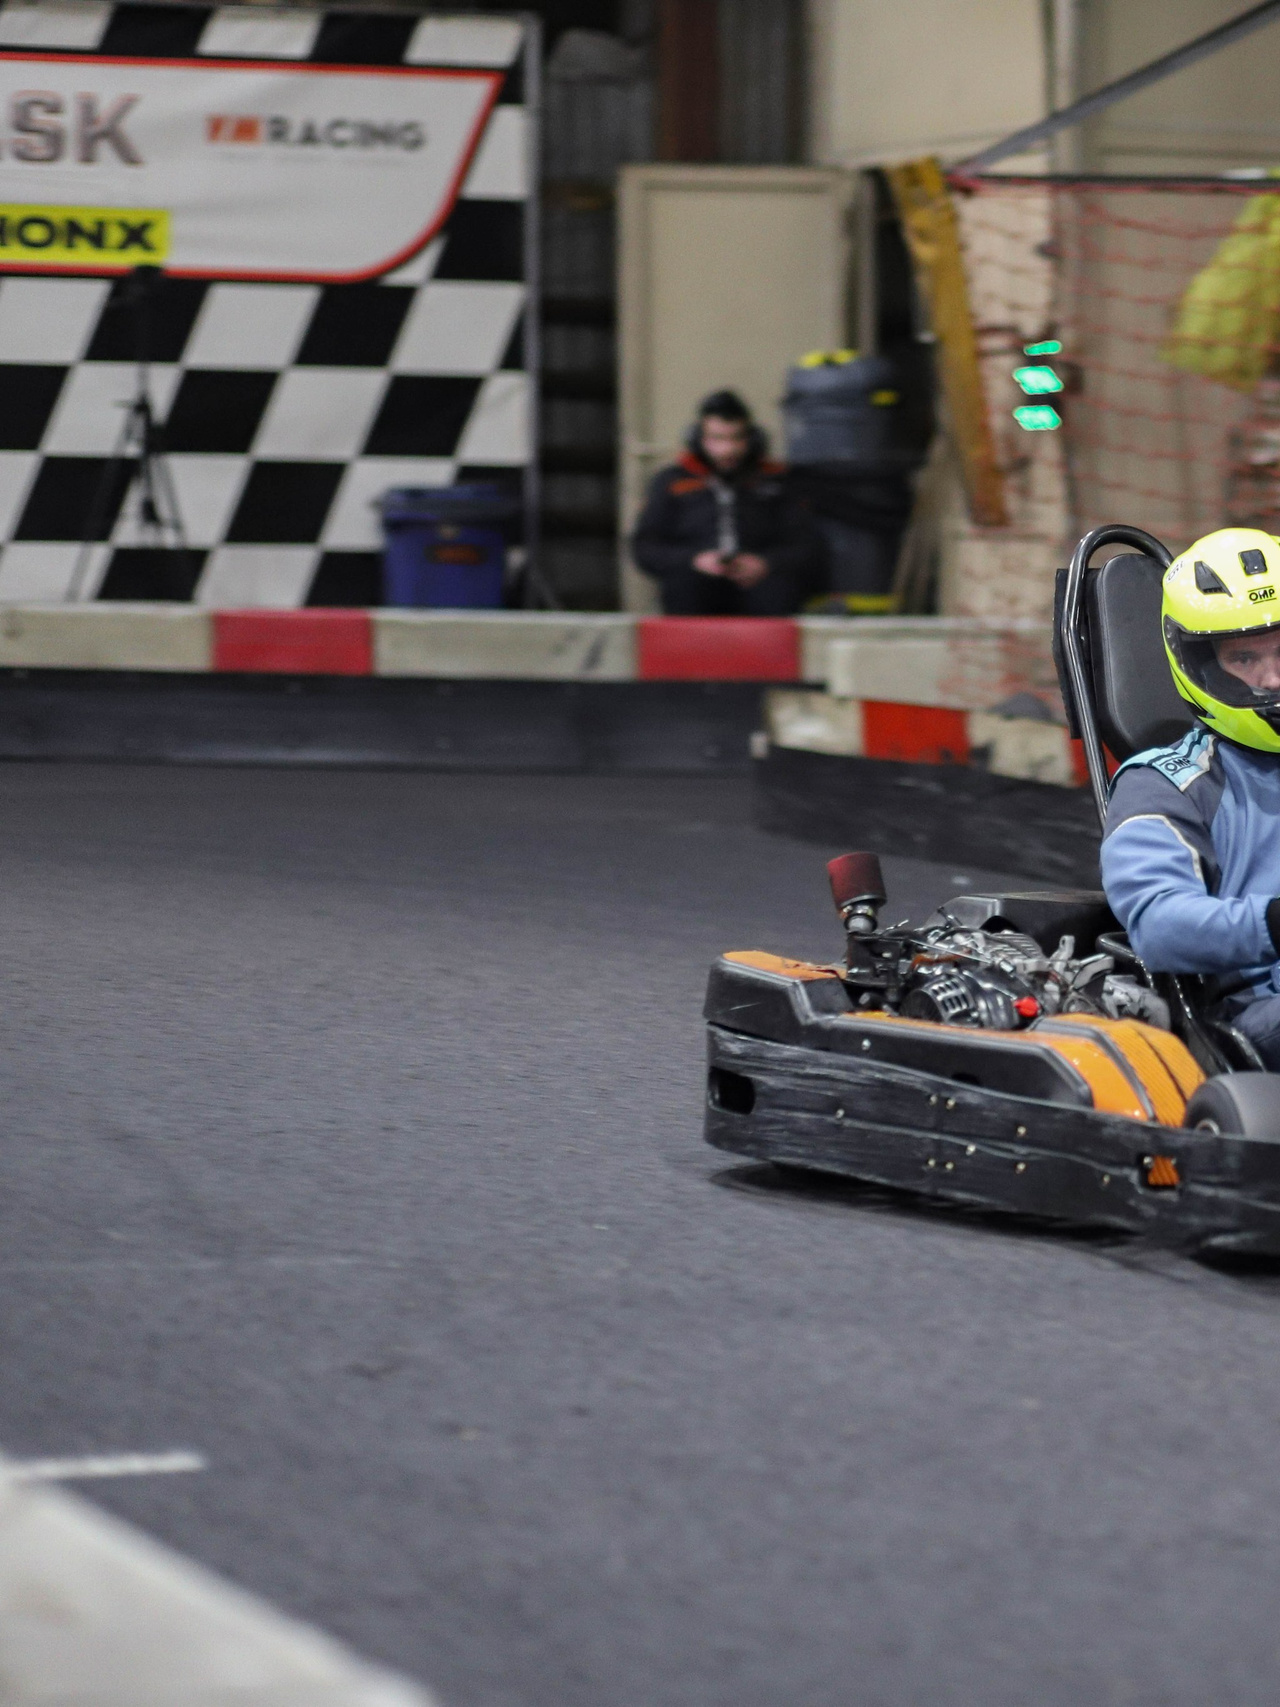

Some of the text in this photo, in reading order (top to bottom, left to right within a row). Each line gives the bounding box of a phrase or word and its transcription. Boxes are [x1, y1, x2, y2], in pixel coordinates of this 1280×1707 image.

[0, 89, 145, 166] SK
[0, 215, 155, 251] ONX
[1248, 588, 1276, 602] OMP
[1163, 756, 1193, 774] OMP
